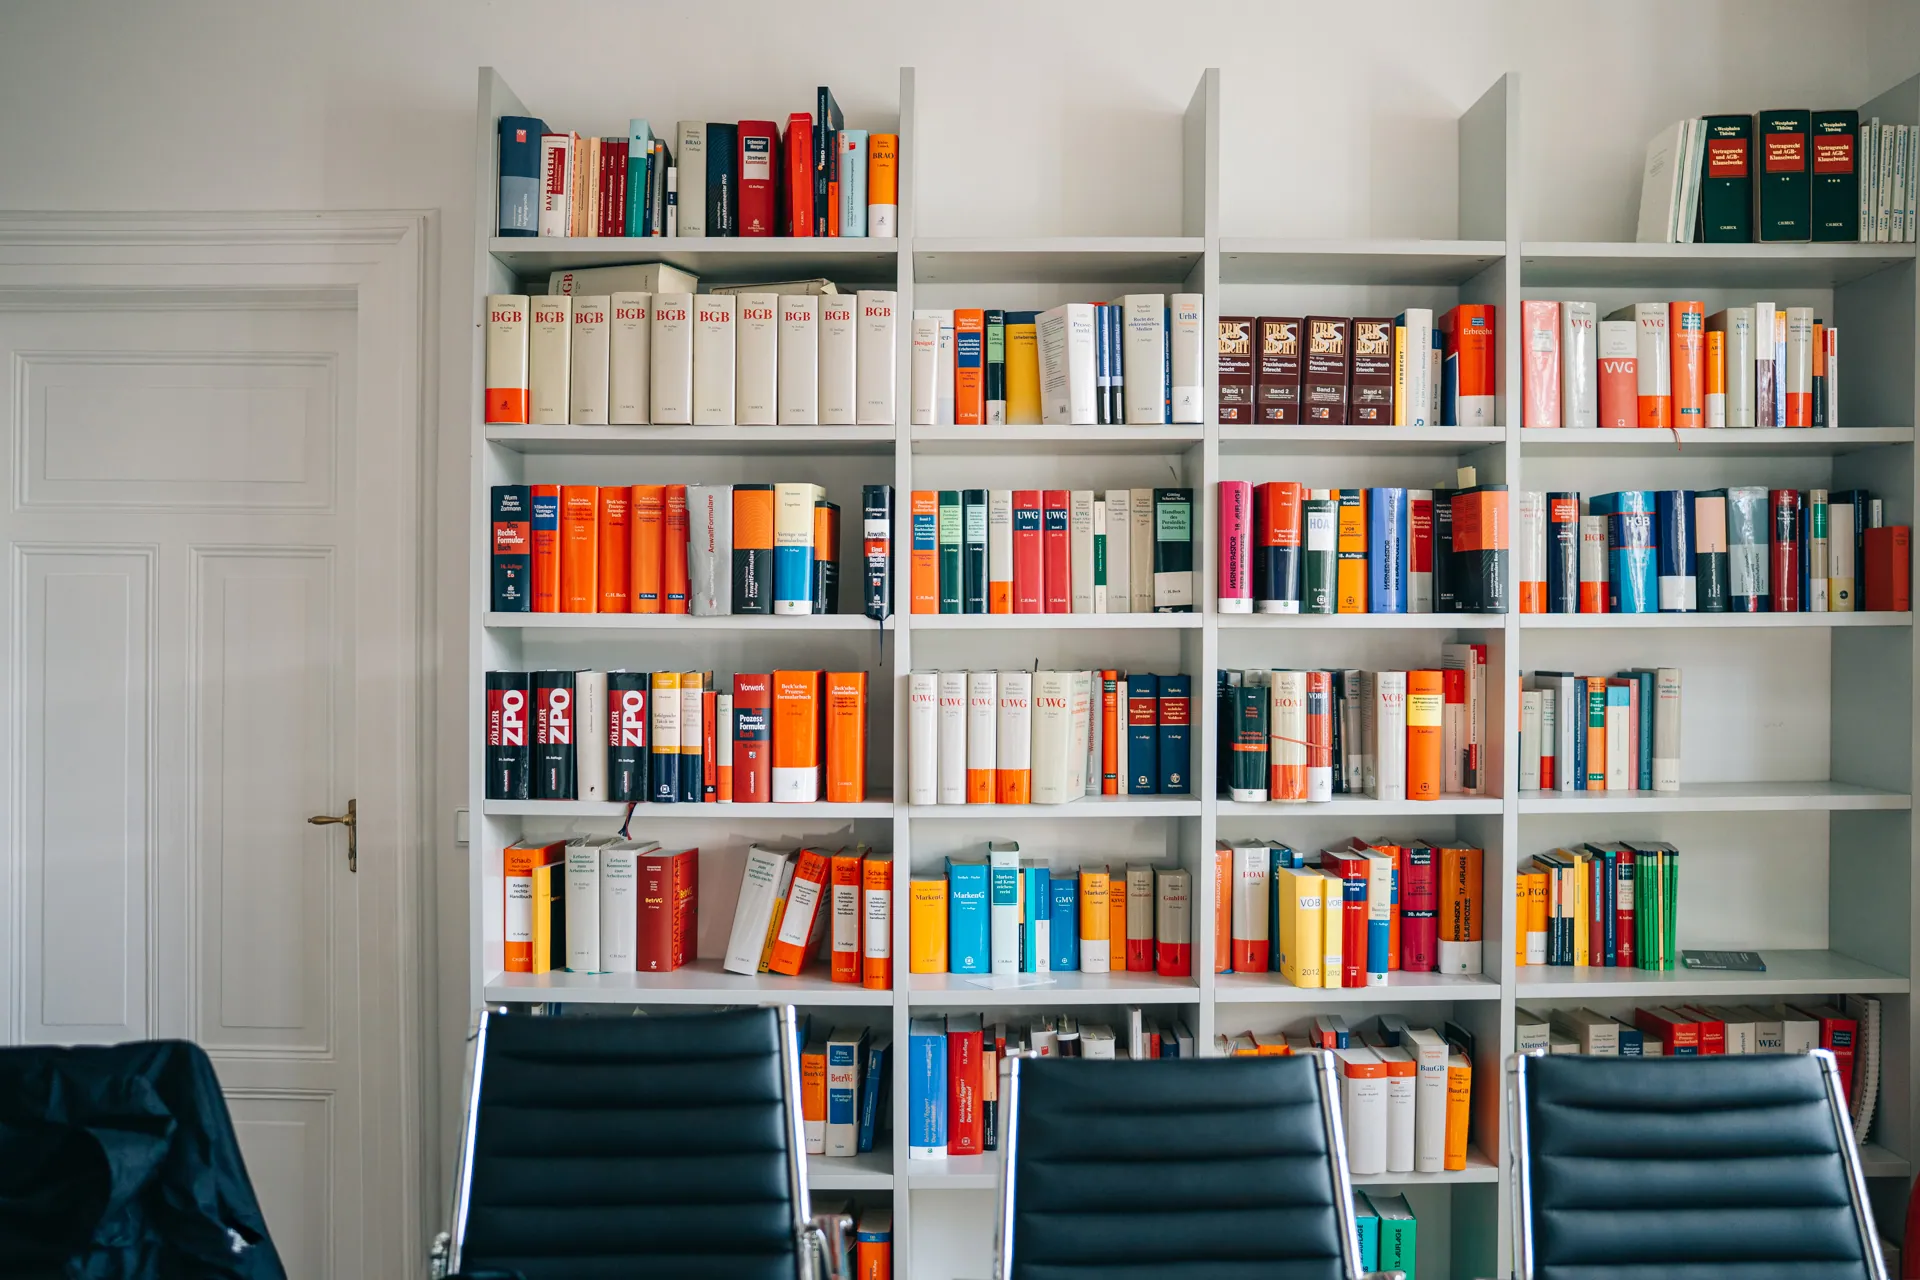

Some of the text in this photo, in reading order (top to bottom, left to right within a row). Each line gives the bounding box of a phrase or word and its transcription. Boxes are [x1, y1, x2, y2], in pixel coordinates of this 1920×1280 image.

[1817, 144, 1849, 152] Vertragsrecht
[872, 152, 895, 160] BRAO
[545, 147, 557, 211] DAV-RATGEBER
[491, 311, 523, 322] BGB
[615, 308, 646, 319] BGB
[656, 309, 687, 320] BGB
[699, 311, 730, 322] BGB
[743, 309, 773, 320] BGB
[784, 311, 811, 321] BGB
[824, 311, 850, 320] BGB
[865, 307, 891, 317] BGB
[535, 311, 566, 323] BGB
[575, 312, 604, 323] BGB
[1179, 313, 1198, 321] UrhR
[1571, 318, 1592, 328] VVG
[1642, 318, 1665, 327] VVG
[1604, 361, 1634, 373] VVG
[1234, 489, 1242, 520] AUFLAGE
[1017, 511, 1039, 520] UWG
[1046, 511, 1067, 519] UWG
[1626, 517, 1651, 526] HGB
[497, 528, 517, 536] Rechts
[1585, 533, 1606, 541] HGB
[740, 683, 765, 691] Vorwerk
[912, 694, 935, 703] UWG
[939, 697, 964, 707] UWG
[1381, 693, 1404, 702] VOB
[1001, 699, 1027, 708] UWG
[1036, 697, 1066, 708] UWG
[1274, 698, 1303, 707] HOAI
[502, 689, 525, 746] ZPO
[549, 688, 570, 744] ZPO
[622, 690, 644, 747] ZPO
[739, 714, 763, 722] Prozess
[491, 710, 500, 746] ZÖLLER
[539, 709, 548, 744] ZÖLLER
[611, 710, 620, 747] ZÖLLER
[510, 856, 532, 864] Schaub
[867, 870, 889, 878] Schaub
[1459, 856, 1467, 886] AUFLAGE
[953, 891, 985, 900] MarkenG
[1528, 887, 1548, 896] FGO
[1055, 896, 1075, 904] GMV
[1300, 898, 1321, 907] VOB
[1520, 1041, 1549, 1050] Mietrecht
[1748, 1039, 1781, 1048] WEG
[1420, 1064, 1445, 1073] BauGB
[830, 1074, 853, 1083] BetrVG
[1448, 1087, 1469, 1095] BauGB
[1394, 1228, 1402, 1257] AUFLAGE
